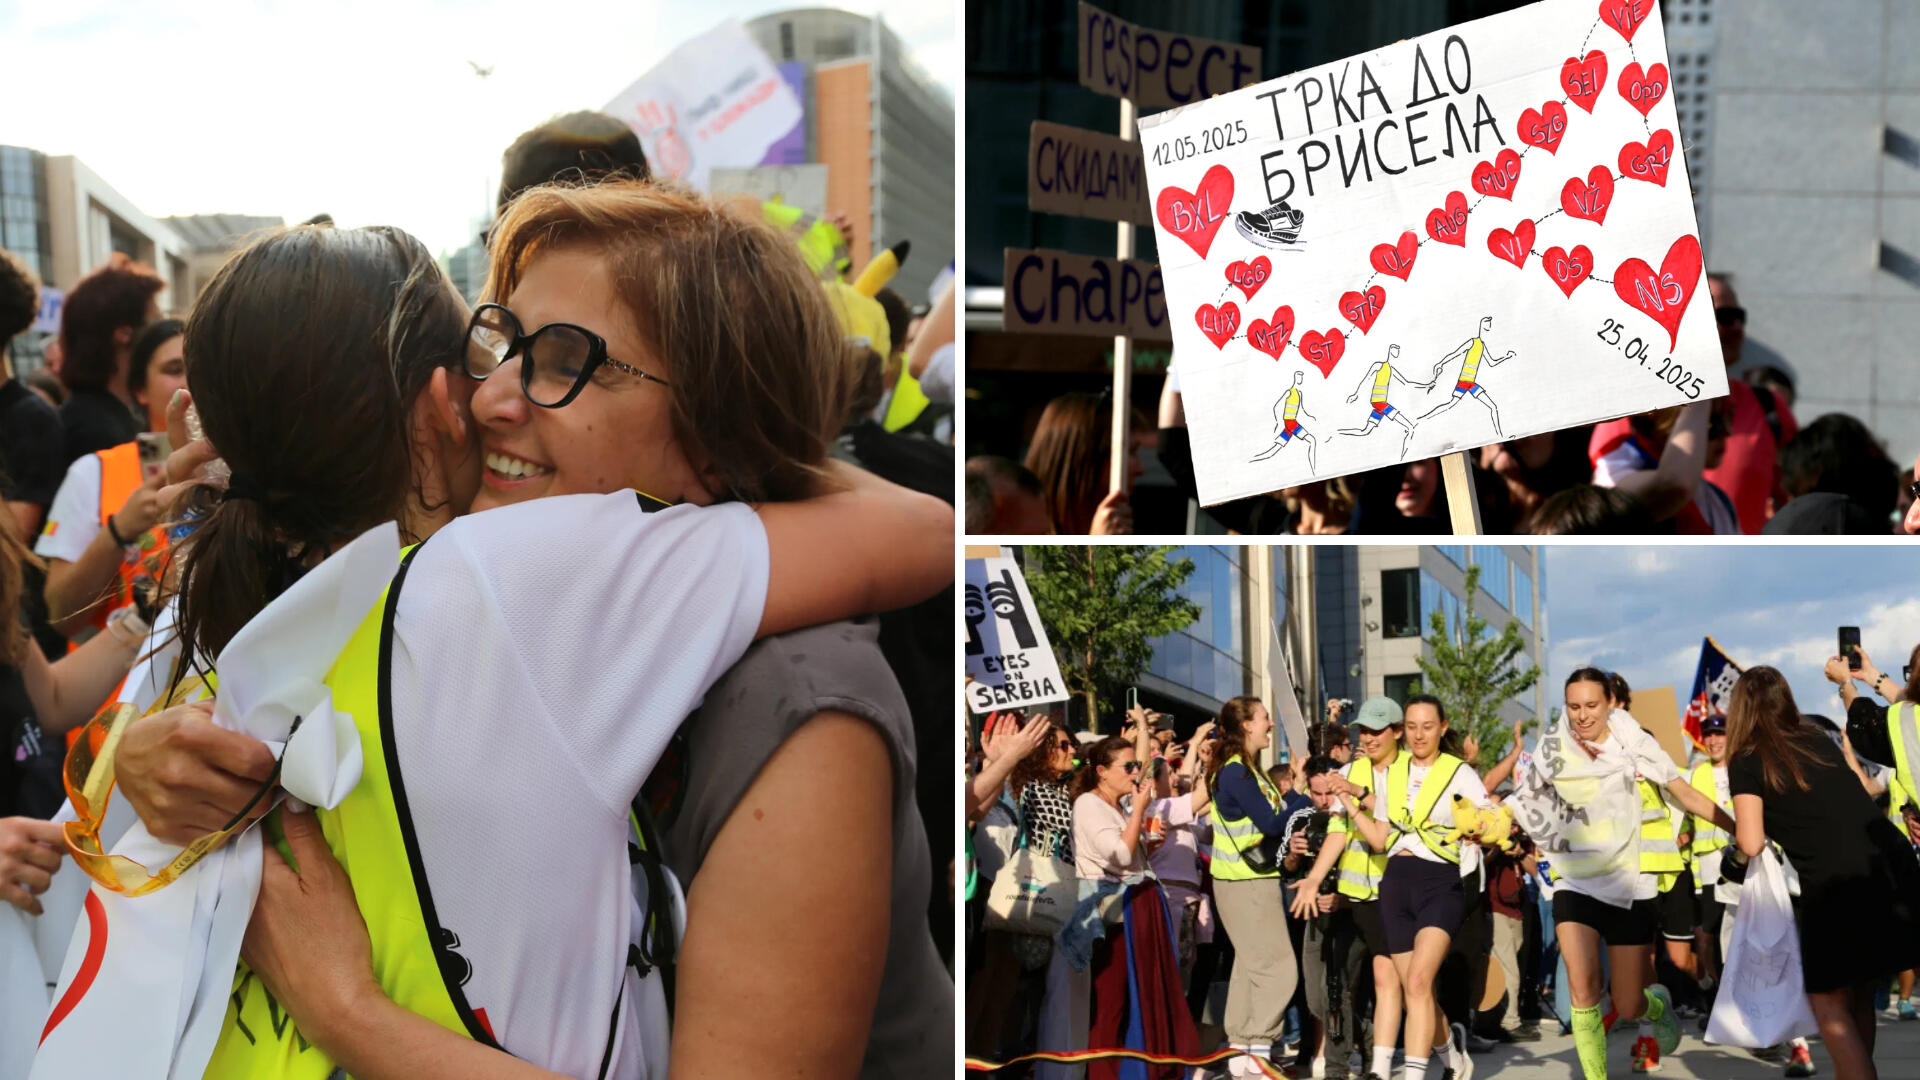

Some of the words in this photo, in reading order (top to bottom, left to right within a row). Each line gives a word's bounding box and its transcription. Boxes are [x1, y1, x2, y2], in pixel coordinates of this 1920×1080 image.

[1087, 12, 1254, 104] respect
[1255, 59, 1393, 141] ТРКА
[1406, 34, 1472, 109] ДО
[1568, 67, 1598, 98] SEI
[1152, 119, 1249, 168] 12.05.2025
[1531, 113, 1565, 144] SZG
[1259, 93, 1506, 206] БРИСЕЛА
[1631, 144, 1670, 177] GRZ
[1480, 160, 1518, 192] MUC
[1170, 188, 1222, 233] BXL
[1434, 210, 1467, 239] AUG
[1383, 249, 1411, 272] UL
[1500, 236, 1523, 261] VI
[1556, 257, 1583, 282] OS
[1635, 272, 1683, 312] NS
[1202, 309, 1237, 336] LUX
[1346, 299, 1380, 323] STR
[1255, 322, 1290, 351] MTZ
[1308, 342, 1336, 361] ST
[1596, 317, 1706, 400] 25.04.2025
[983, 653, 1030, 673] EYES
[976, 677, 1057, 708] SERBIA
